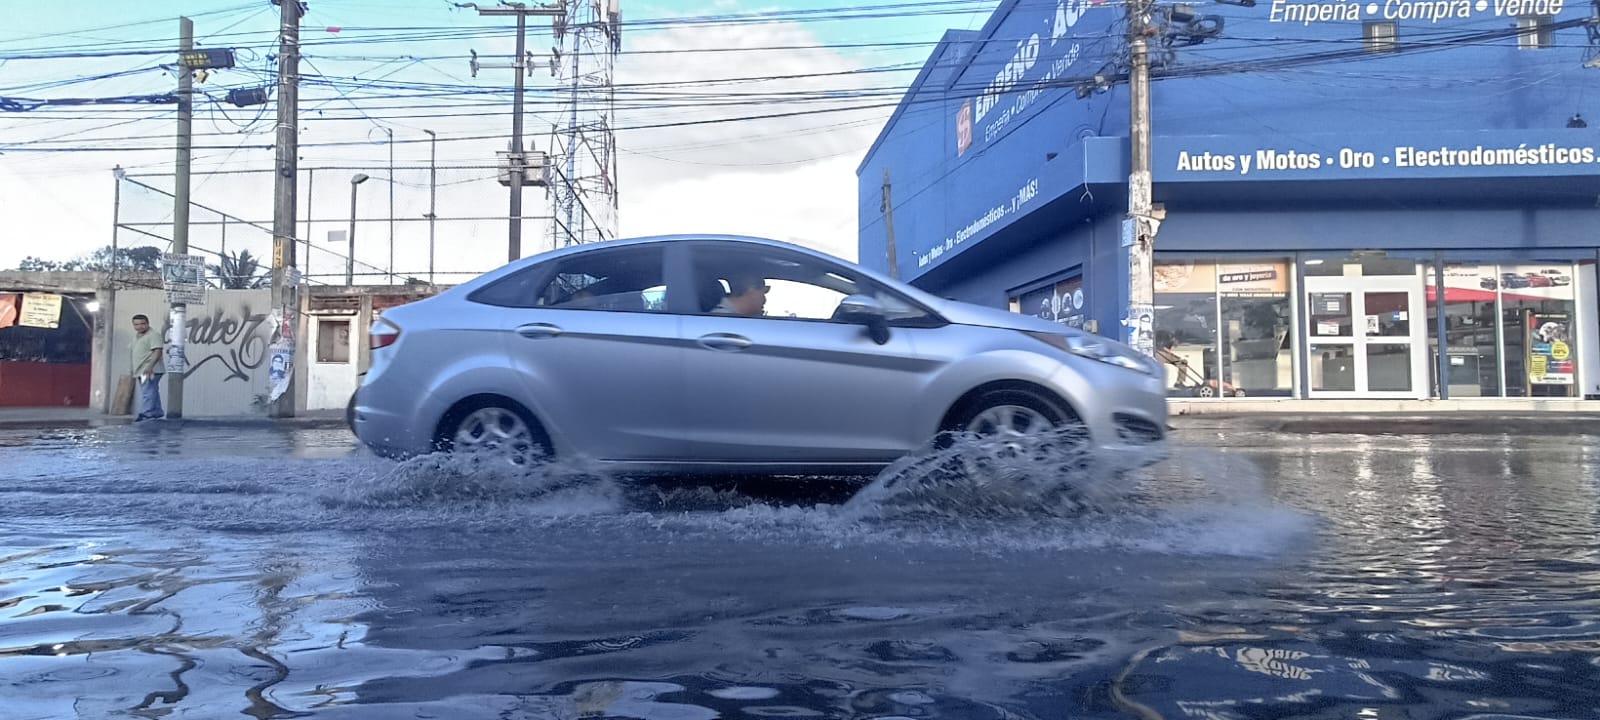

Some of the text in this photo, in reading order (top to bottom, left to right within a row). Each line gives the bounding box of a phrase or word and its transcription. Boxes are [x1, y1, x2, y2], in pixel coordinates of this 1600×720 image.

[1269, 0, 1563, 26] Empeña Compra Vende
[1052, 43, 1080, 79] Vende
[975, 33, 1040, 124] EMPEÑO
[1177, 151, 1235, 171] Autos
[1240, 154, 1252, 174] y
[1256, 150, 1320, 169] Motos
[1340, 148, 1375, 168] Oro
